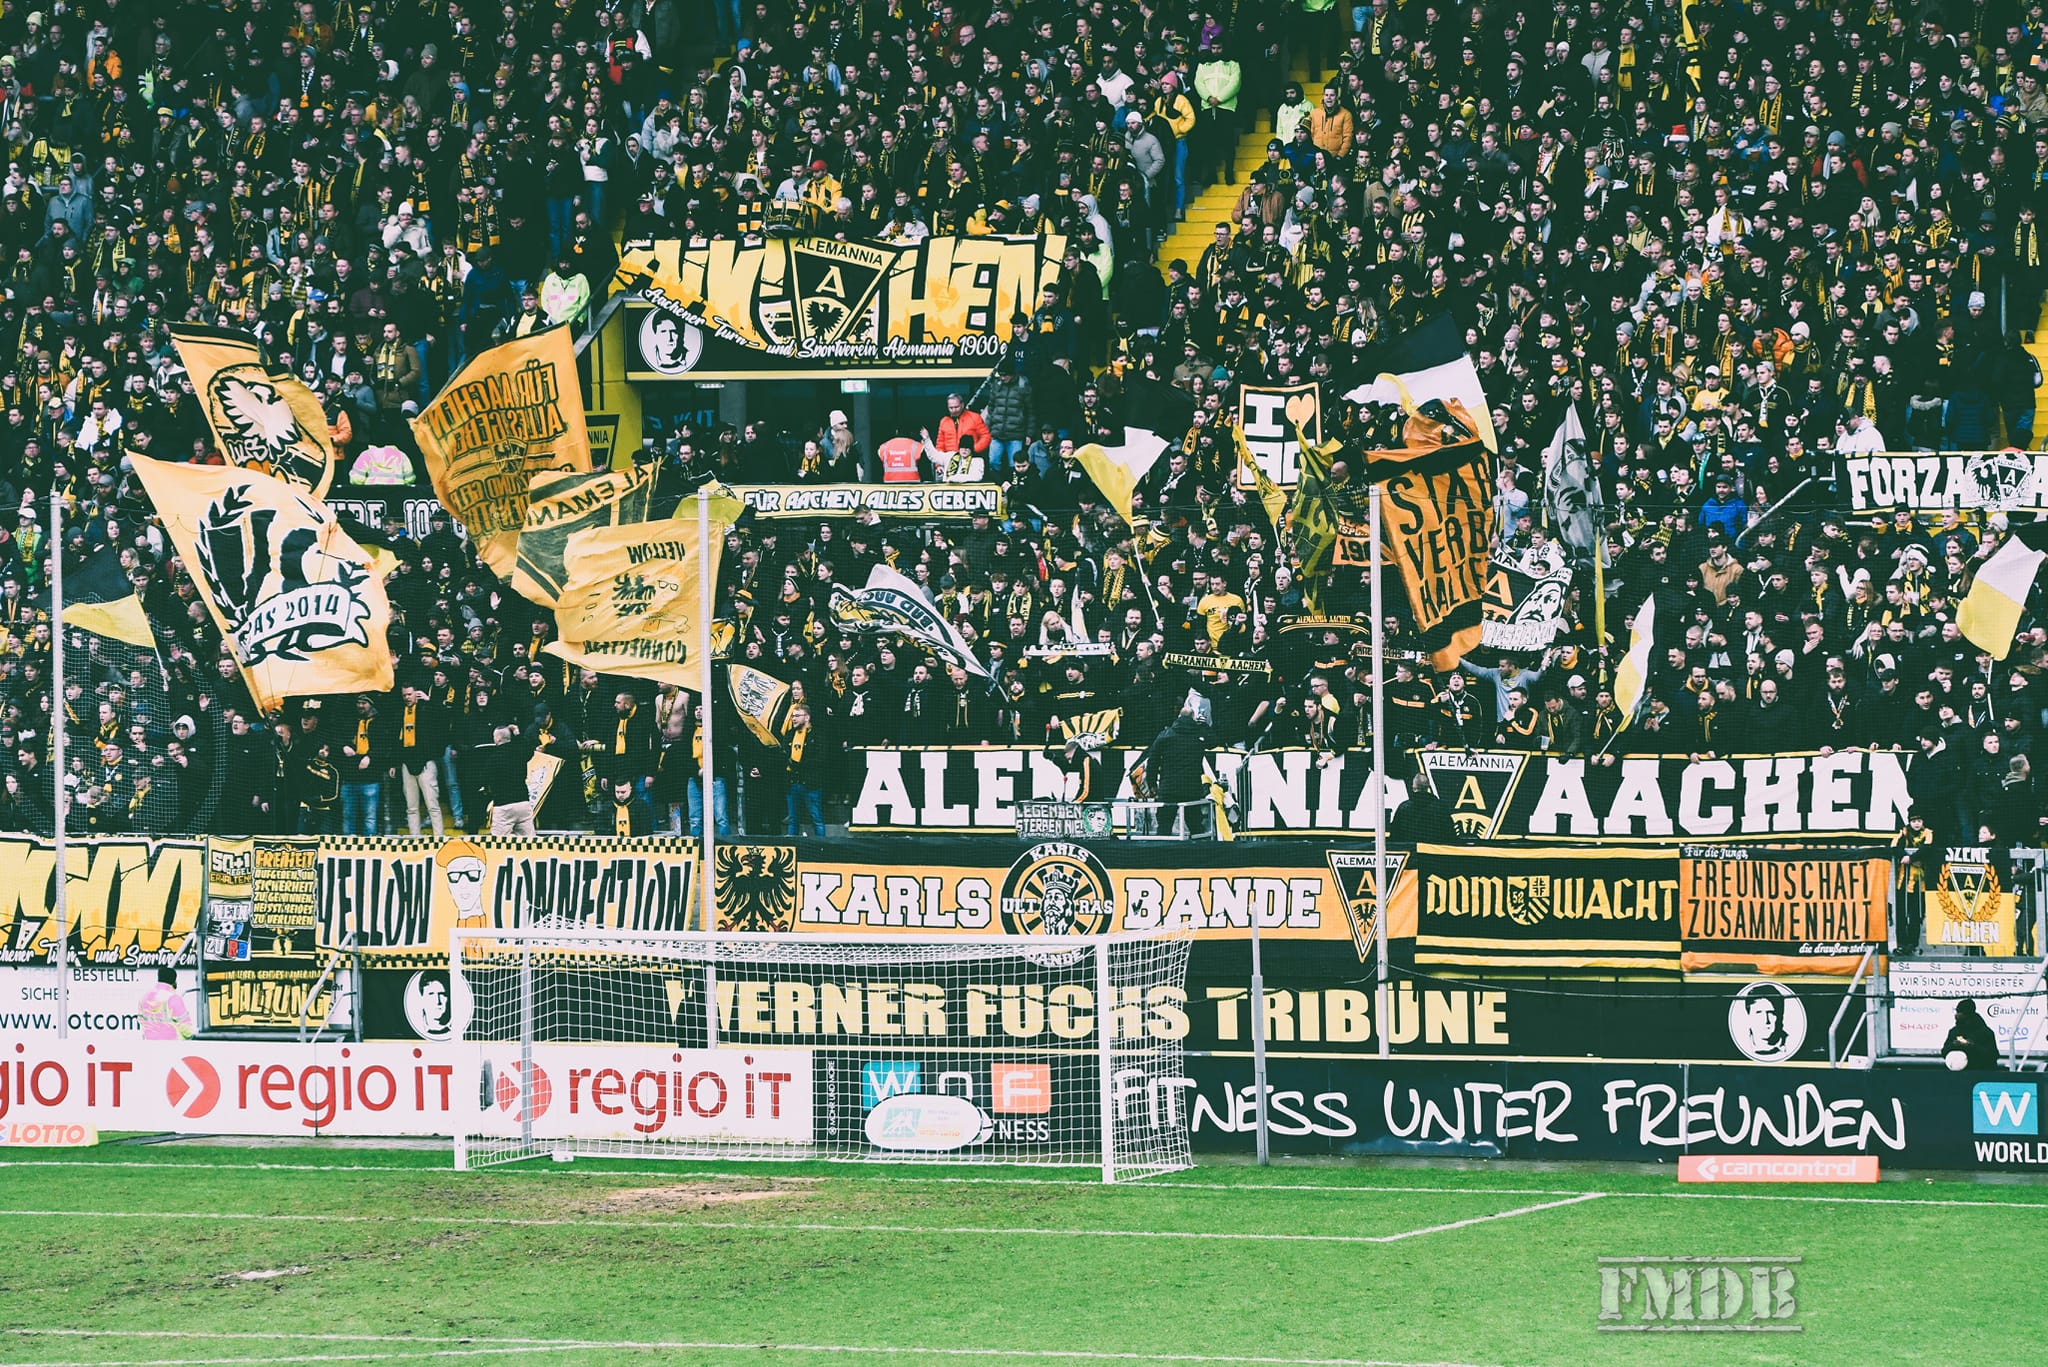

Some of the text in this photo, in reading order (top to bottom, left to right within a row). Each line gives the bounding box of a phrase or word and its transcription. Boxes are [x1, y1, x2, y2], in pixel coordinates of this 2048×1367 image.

[796, 237, 883, 267] ALEMANNIA
[815, 265, 847, 298] A
[645, 287, 707, 327] Aachener
[713, 316, 760, 348] Turn-
[766, 342, 794, 358] und
[798, 336, 878, 359] Sportverein
[883, 335, 955, 358] Alemannia
[960, 335, 999, 357] 1900
[1243, 393, 1286, 438] I
[1847, 455, 1966, 510] FORZA
[745, 489, 997, 512] FÜR AACHEN ALLES GEBEN!
[285, 593, 340, 622] 2014
[1166, 653, 1267, 672] ALEMANNIA AACHEN
[1429, 755, 1516, 770] ALEMANNIA
[1455, 775, 1486, 810] A
[1529, 752, 1913, 835] AACHEN
[1017, 804, 1083, 819] LEGENDEN
[1016, 818, 1065, 834] STERBEN
[255, 849, 316, 869] FREIHEIT
[1030, 843, 1090, 863] KARLS
[1685, 846, 1703, 858] Für
[1704, 847, 1719, 858] die
[1945, 847, 1990, 864] SZENE
[254, 880, 314, 892] SICHERHEIT
[1692, 860, 1870, 901] FREUNDSCHAFT
[1963, 875, 1976, 890] A
[253, 891, 266, 902] ZU
[316, 856, 433, 947] YELLOW
[494, 856, 692, 944] CONNECTION
[799, 871, 992, 929] KARLS
[1122, 877, 1323, 930] BANDE
[1552, 877, 1679, 922] WACHT
[211, 903, 249, 921] NEIN
[253, 914, 266, 925] ZU
[1687, 899, 1872, 941] ZUSAMMENHALT
[1941, 920, 2000, 944] AACHEN
[95, 948, 119, 962] und
[206, 937, 249, 959] ZU RB
[73, 968, 140, 982] BESTELLT.
[1899, 977, 2025, 988] WIR SIND AUTORISIERTER
[220, 980, 326, 1020] HALTUNG
[666, 980, 1509, 1047] WERNER FUCHS TRIBÜNE
[86, 1043, 133, 1108] iT
[828, 1060, 836, 1083] MORE
[237, 1047, 397, 1129] regio
[568, 1052, 792, 1134] regio iT
[828, 1084, 836, 1101] UND
[1112, 1068, 1906, 1151] FITNESS UNTER FREUNDEN
[1979, 1090, 2031, 1127] W
[9, 1124, 85, 1144] LOTTO
[1722, 1157, 1857, 1178] camcontrol
